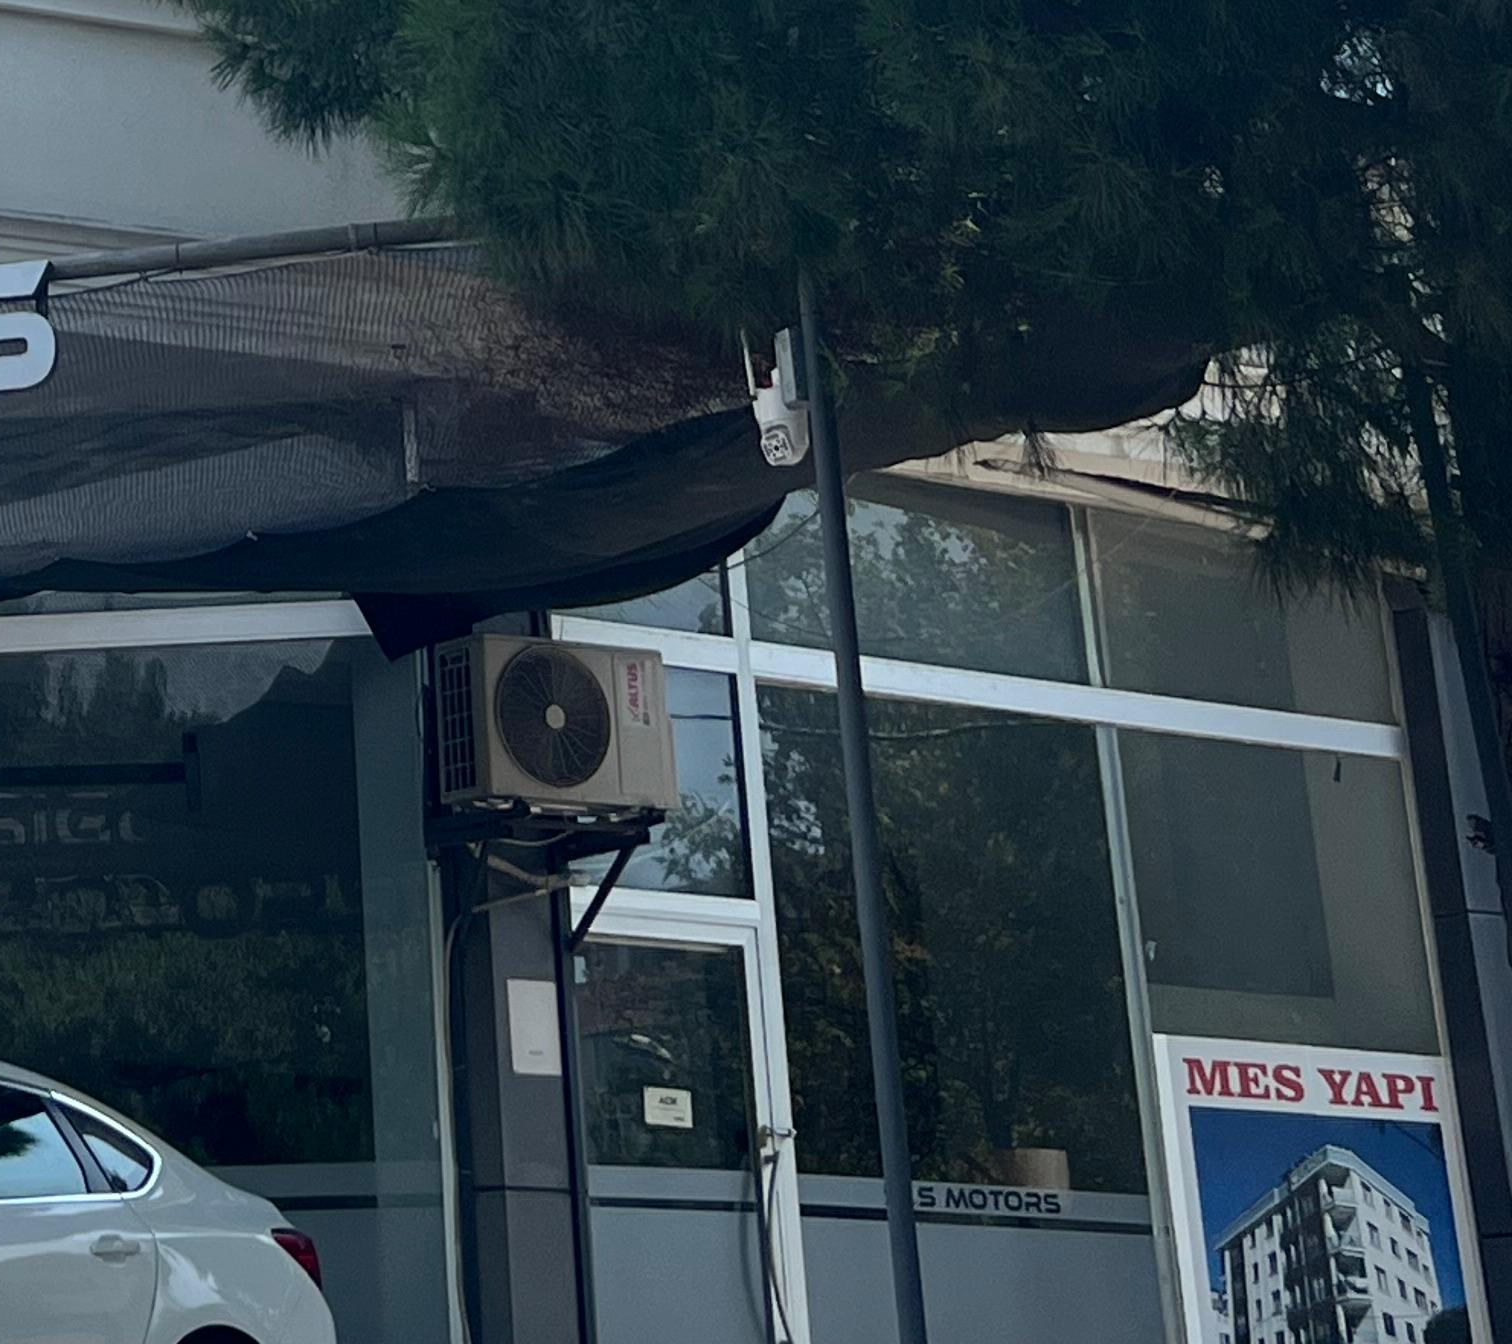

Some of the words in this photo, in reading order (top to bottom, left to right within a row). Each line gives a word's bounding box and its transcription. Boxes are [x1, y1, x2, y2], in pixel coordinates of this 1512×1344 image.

[1182, 1057, 1305, 1103] MES
[1317, 1067, 1439, 1113] YAPI
[945, 1187, 1061, 1215] MOTORS
